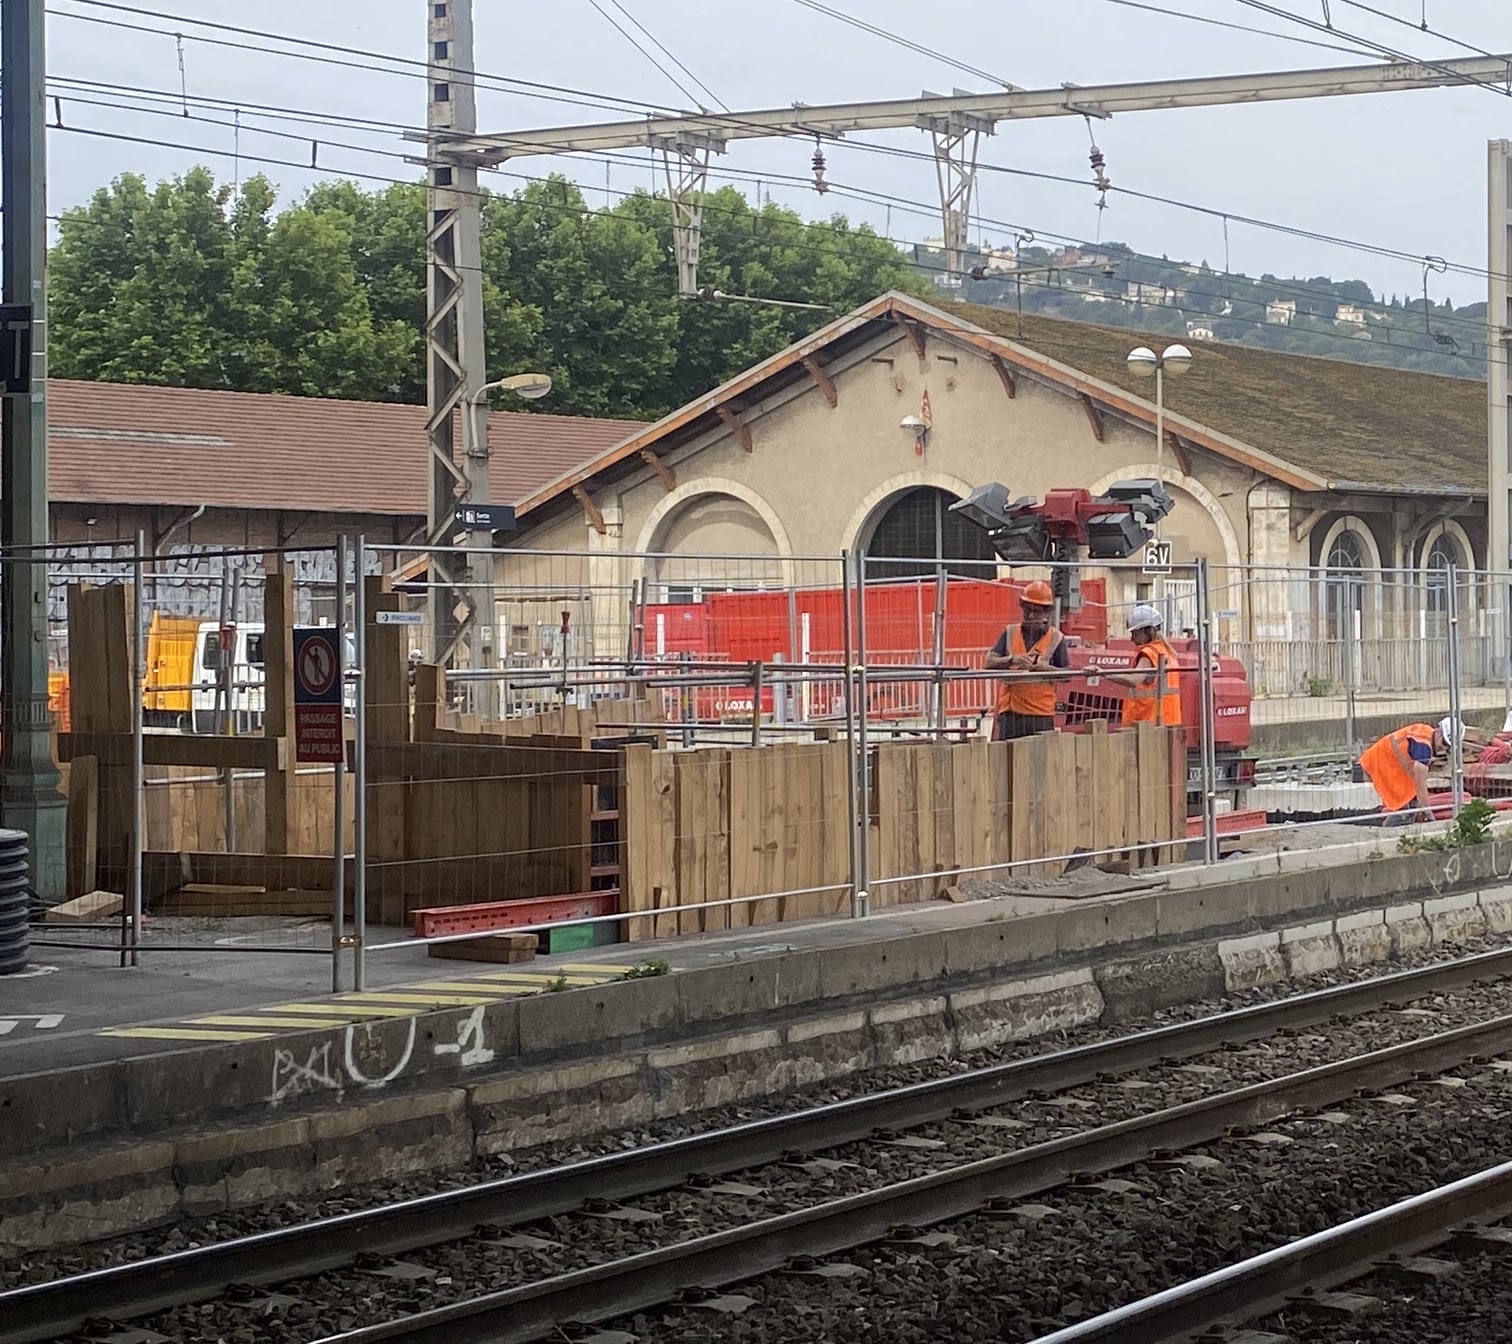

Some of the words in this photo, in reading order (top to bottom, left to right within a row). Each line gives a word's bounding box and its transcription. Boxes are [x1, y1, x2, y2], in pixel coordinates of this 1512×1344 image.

[1146, 546, 1169, 566] 6V
[1096, 656, 1131, 666] LOXAM
[299, 713, 338, 725] PASSAGE
[301, 728, 337, 740] INTERDIT
[298, 743, 311, 754] AU
[311, 743, 341, 755] PUBLIC
